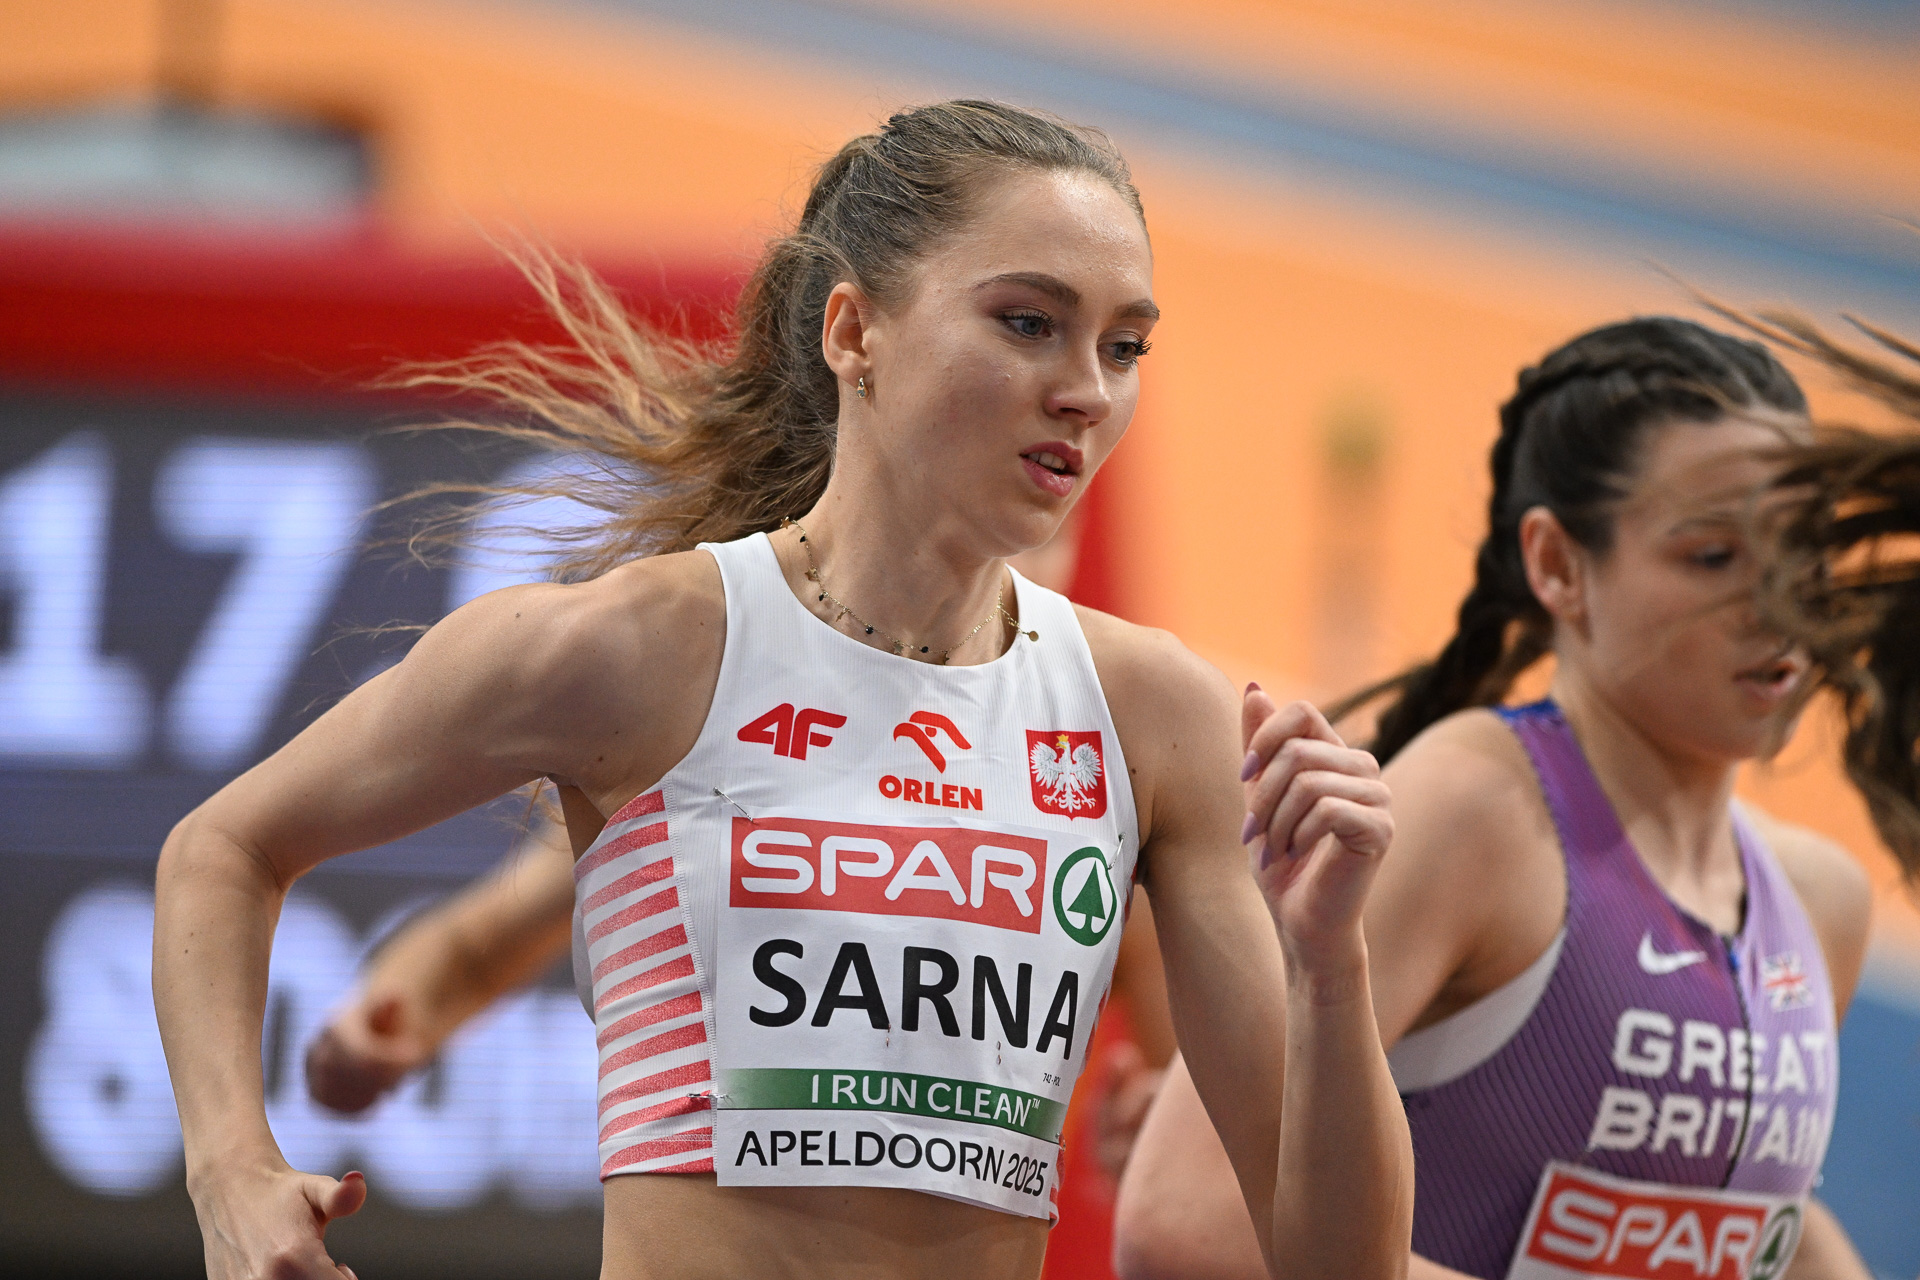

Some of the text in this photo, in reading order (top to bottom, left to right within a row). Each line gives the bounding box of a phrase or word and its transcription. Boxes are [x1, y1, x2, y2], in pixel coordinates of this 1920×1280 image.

[737, 702, 847, 761] 4F
[878, 775, 983, 811] ORLEN
[741, 829, 1037, 918] SPAR
[749, 938, 1079, 1060] SARNA
[1612, 1008, 1828, 1096] GREAT
[811, 1073, 819, 1104] I
[832, 1074, 917, 1109] RUN
[735, 1130, 1048, 1197] APELDOORN 2025
[1541, 1190, 1762, 1277] SPAR
